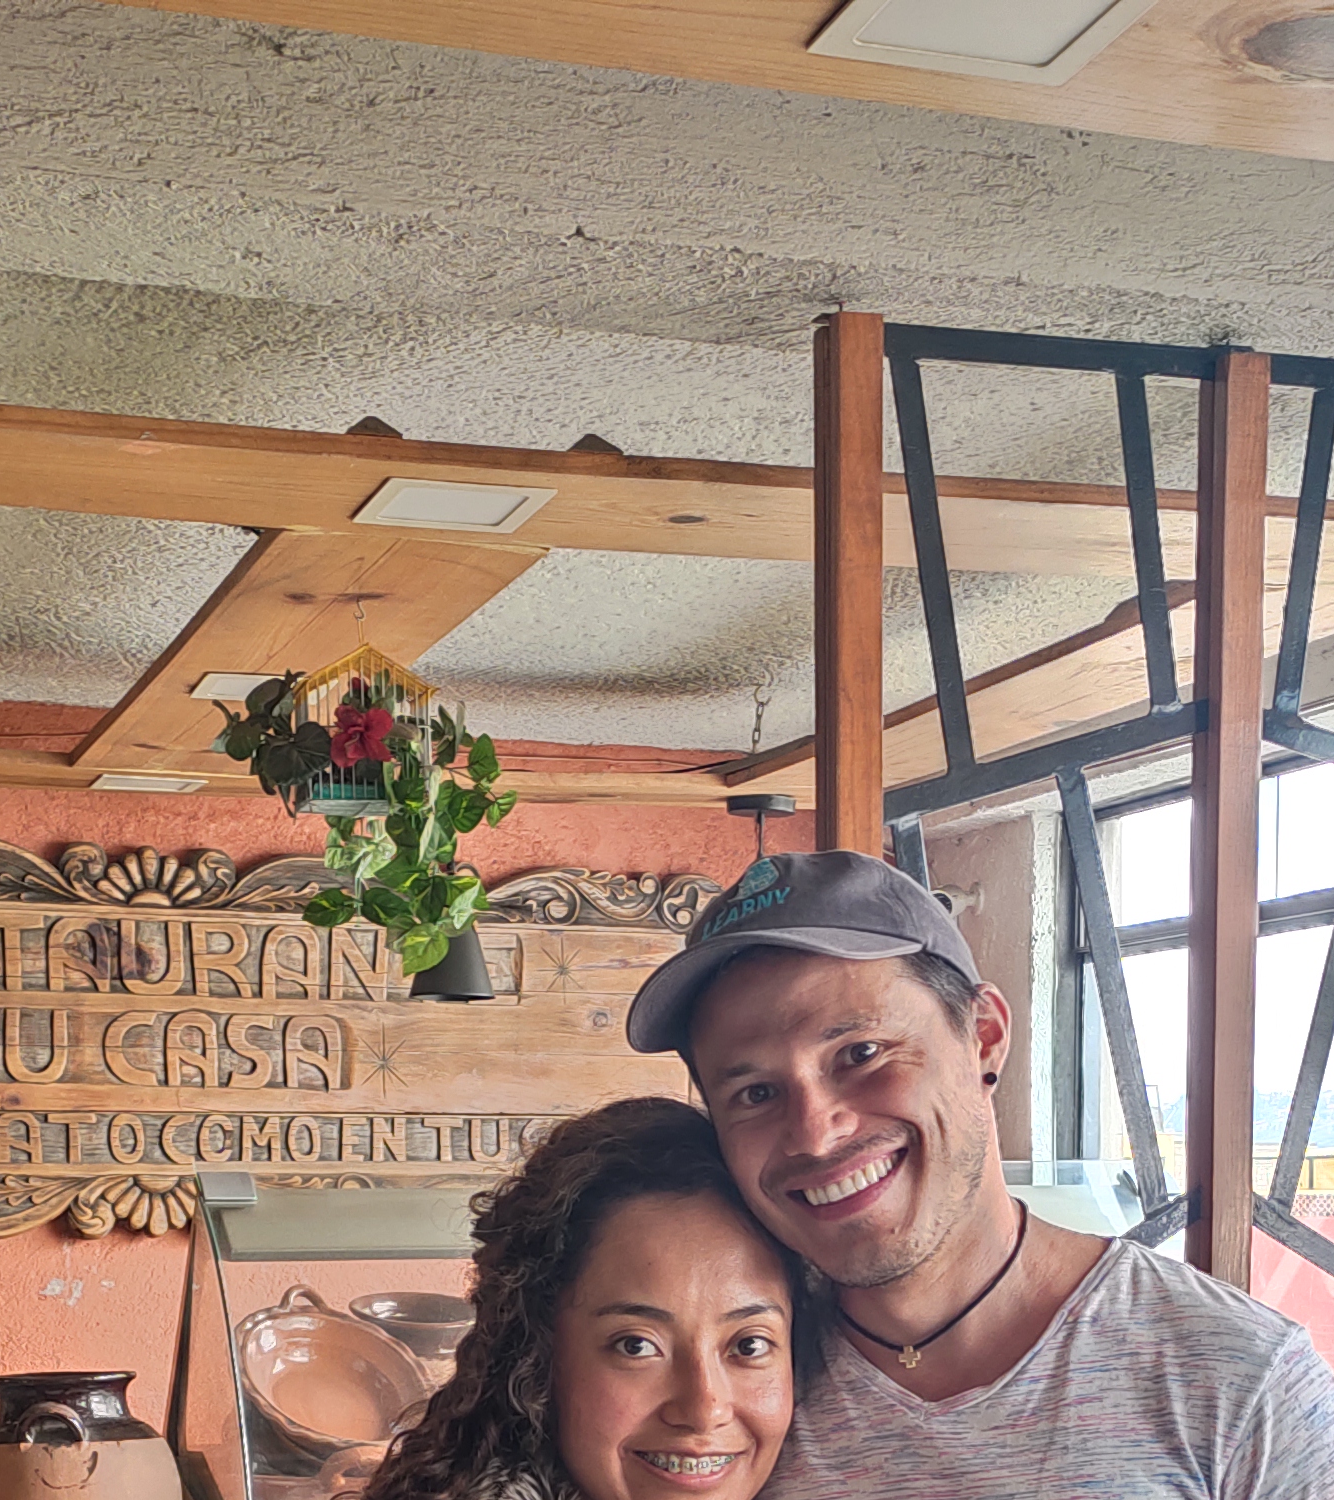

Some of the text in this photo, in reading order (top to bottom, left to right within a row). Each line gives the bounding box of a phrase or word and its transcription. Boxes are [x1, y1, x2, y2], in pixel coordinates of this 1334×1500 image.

[702, 887, 790, 940] LEARNY
[103, 1008, 346, 1091] CASA
[160, 1113, 322, 1164] COMO
[339, 1116, 407, 1163] EN
[423, 1116, 510, 1163] TU
